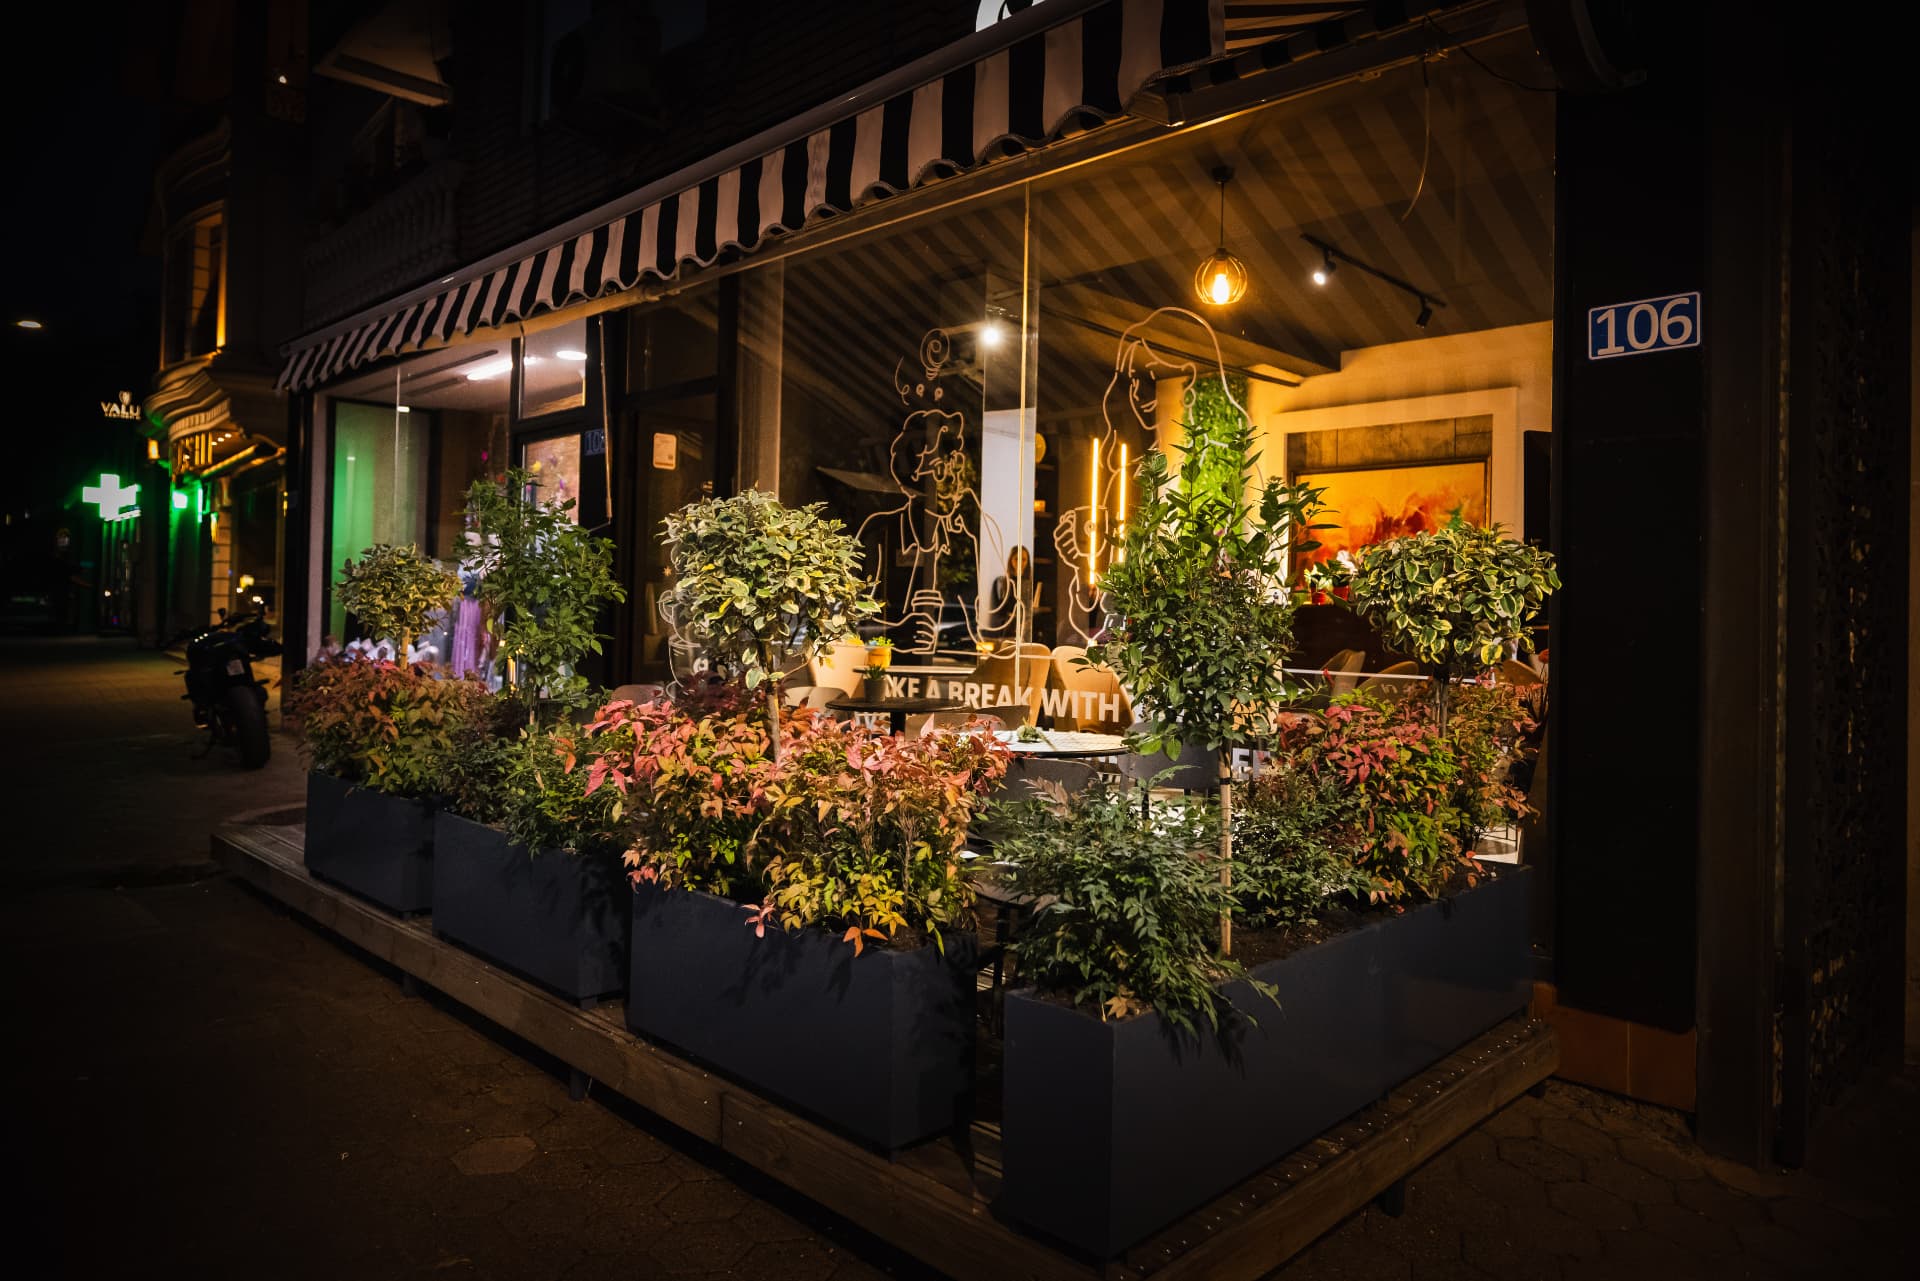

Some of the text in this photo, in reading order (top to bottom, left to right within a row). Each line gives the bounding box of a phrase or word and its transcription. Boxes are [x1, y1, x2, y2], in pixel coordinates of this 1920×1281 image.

[1596, 297, 1693, 356] 106
[926, 679, 941, 699] A
[948, 680, 1033, 709] BREAK
[1041, 687, 1120, 723] WITH
